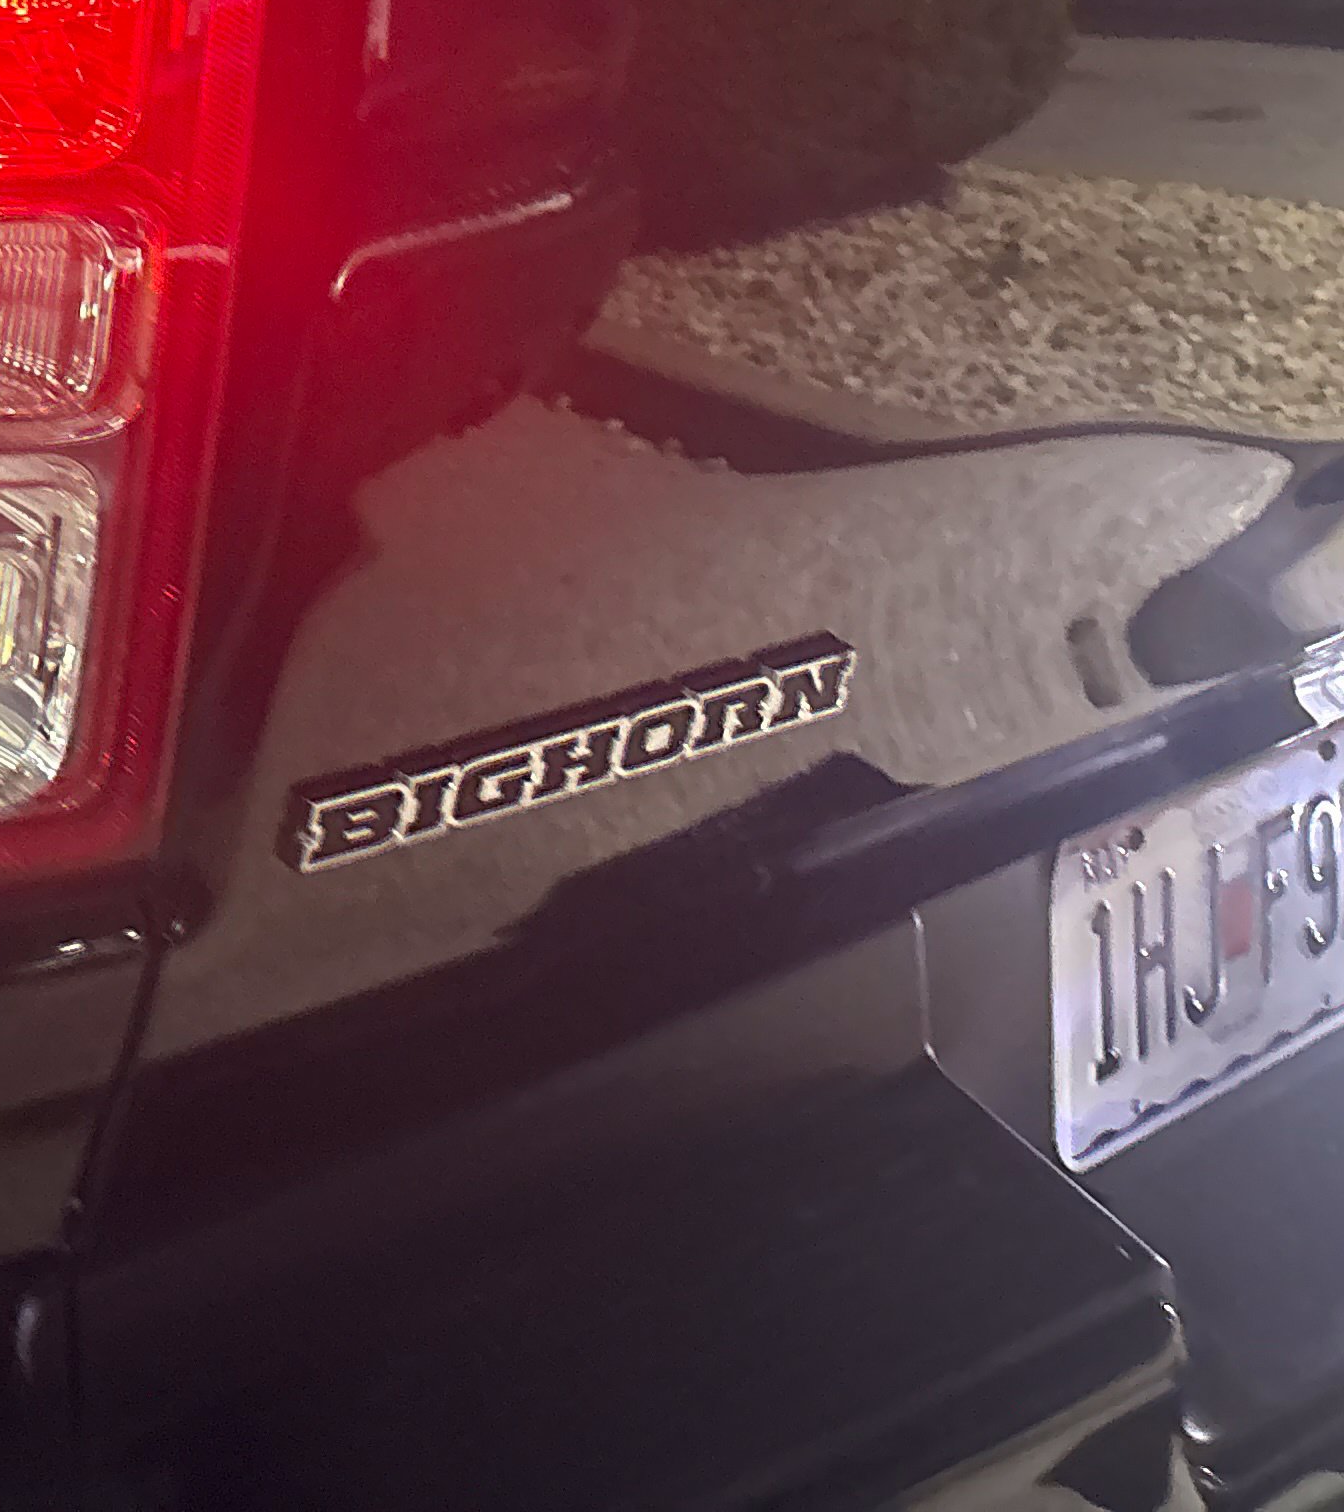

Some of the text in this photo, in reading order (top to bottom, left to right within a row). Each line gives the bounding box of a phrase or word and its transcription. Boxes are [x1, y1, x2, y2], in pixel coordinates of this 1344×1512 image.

[297, 648, 857, 874] BIGHORN
[1091, 790, 1344, 1086] 1HJ F9
